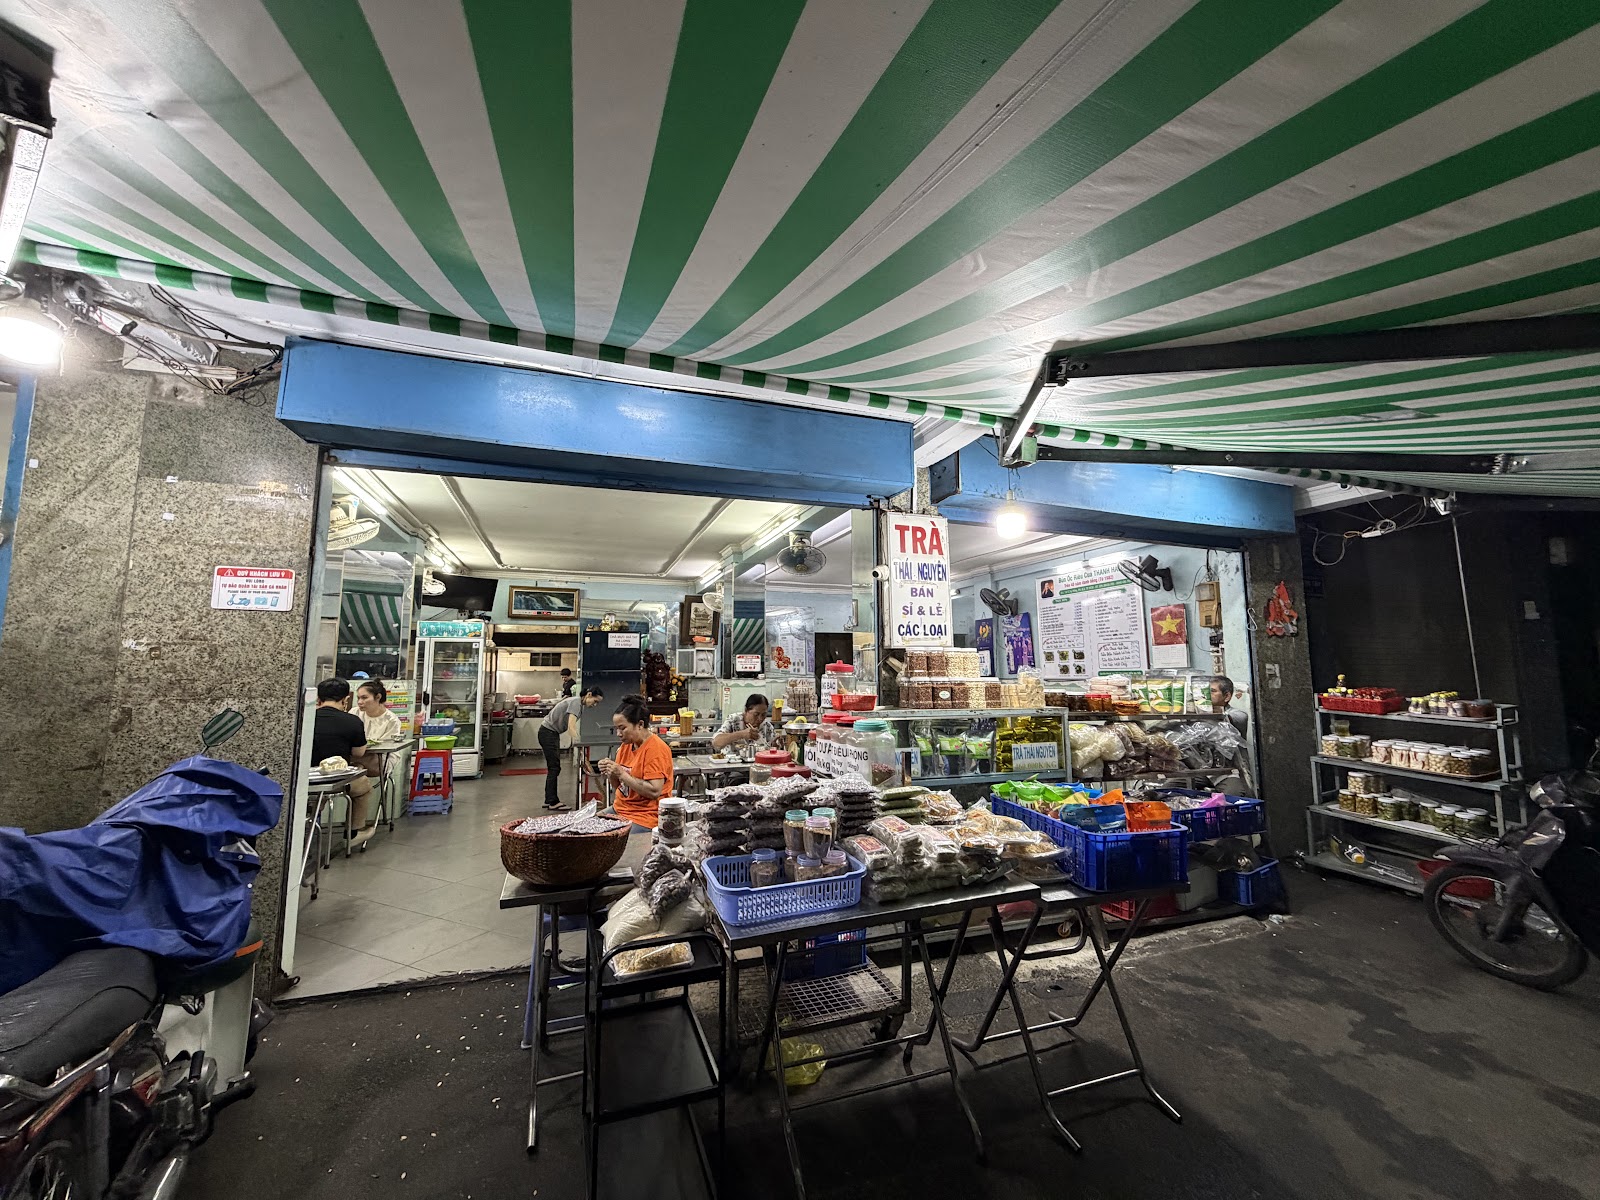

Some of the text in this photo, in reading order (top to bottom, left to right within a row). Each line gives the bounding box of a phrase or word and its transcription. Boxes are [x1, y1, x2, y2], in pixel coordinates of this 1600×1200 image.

[895, 521, 944, 555] TRÀ
[894, 558, 947, 581] THÁI NGUYÊN
[910, 586, 934, 597] BÁN
[902, 602, 943, 616] SỈ & LẺ
[897, 622, 920, 637] CÁC
[1013, 744, 1056, 760] TRÀ THÁI NGUYÊN
